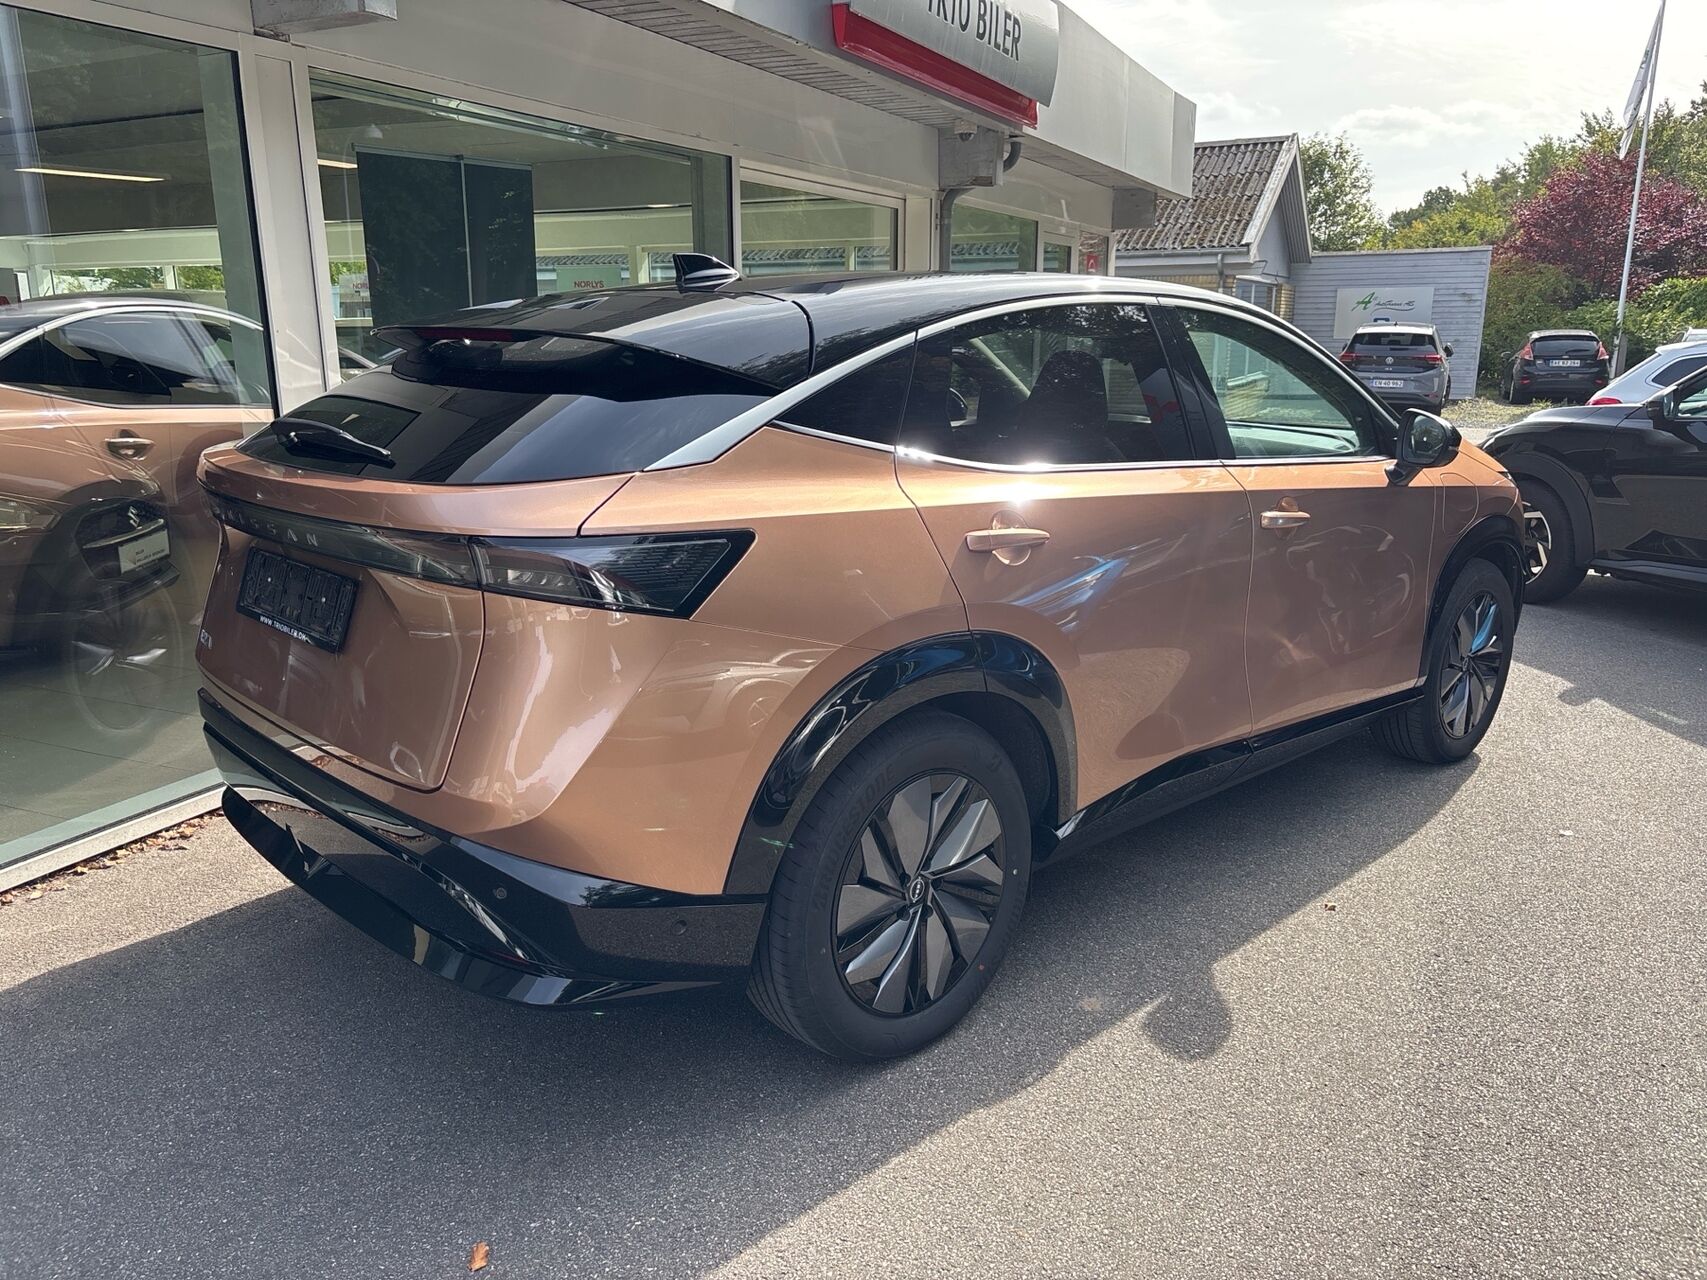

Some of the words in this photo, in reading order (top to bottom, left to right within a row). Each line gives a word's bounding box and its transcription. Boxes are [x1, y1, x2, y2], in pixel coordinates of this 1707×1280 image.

[926, 0, 971, 33] IO
[975, 0, 1021, 62] BILER
[574, 280, 605, 289] NORLYS
